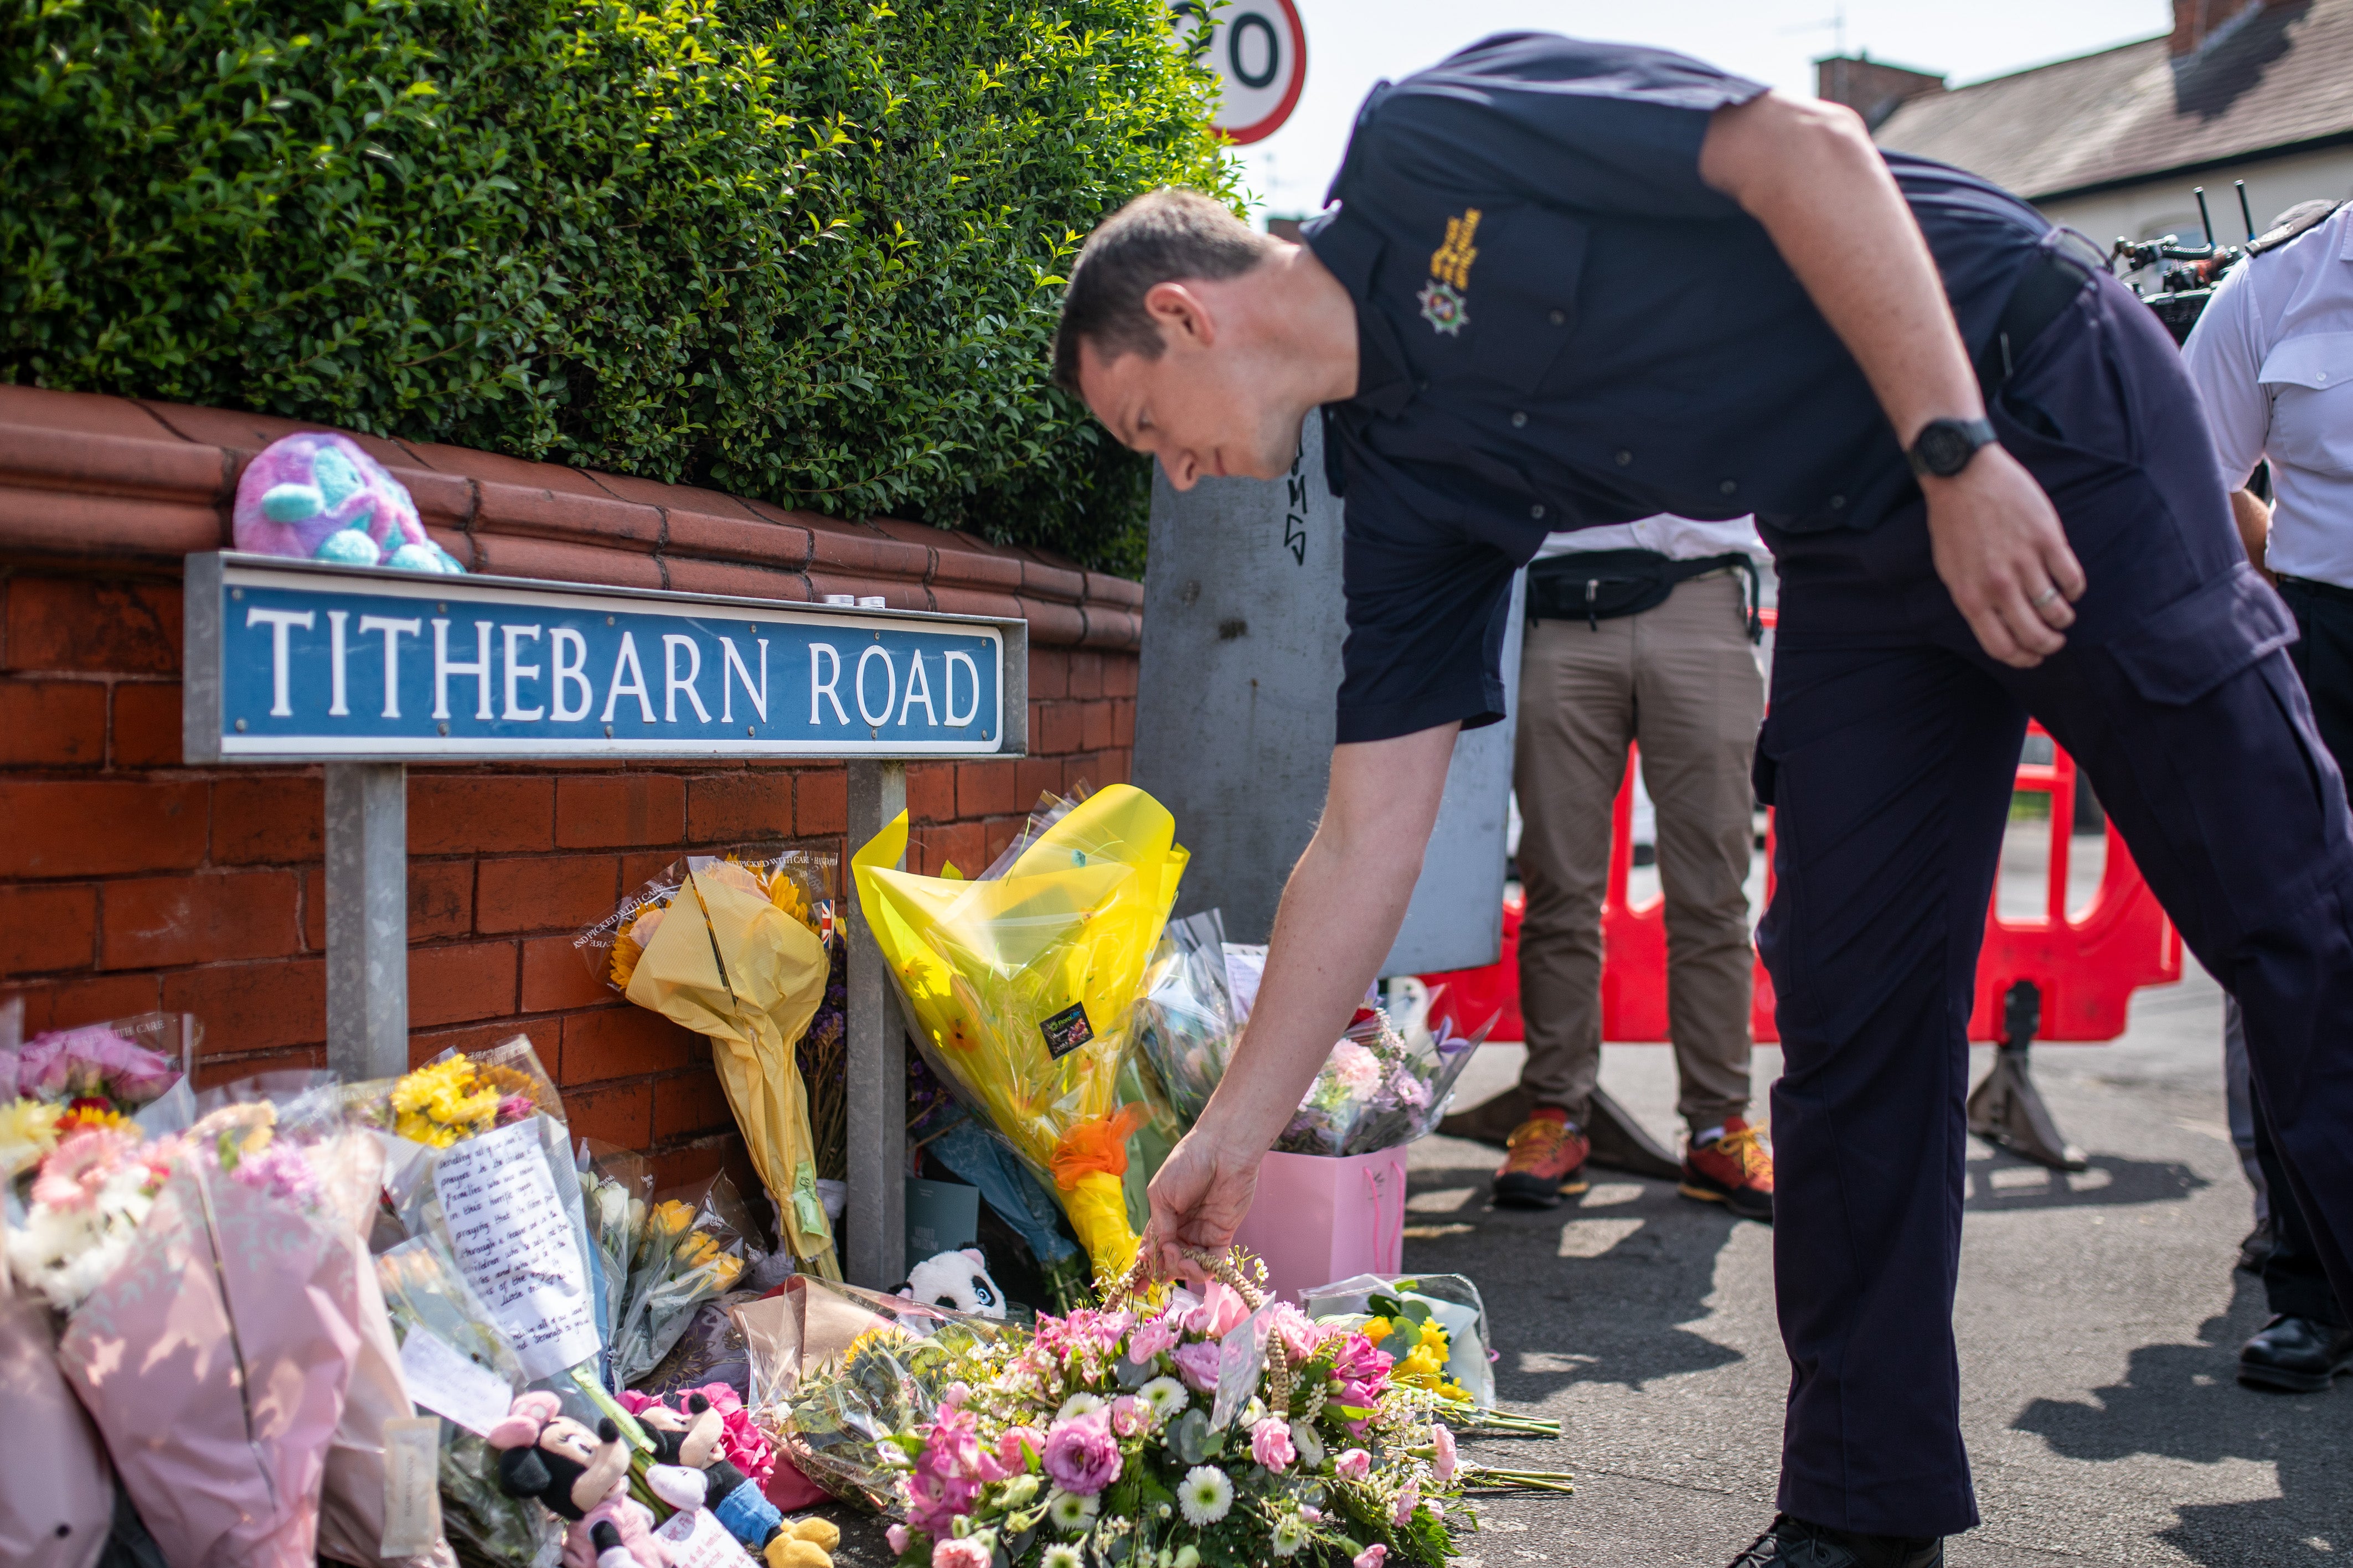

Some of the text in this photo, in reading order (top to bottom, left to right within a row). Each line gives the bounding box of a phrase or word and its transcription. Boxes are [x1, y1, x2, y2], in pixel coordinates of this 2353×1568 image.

[246, 607, 981, 728] TITHEBARN ROAD
[739, 859, 770, 868] PICKED
[769, 856, 793, 866] WITH
[586, 913, 620, 940] PICKED
[617, 898, 643, 918] WITH
[641, 882, 666, 902] CARE
[136, 1020, 165, 1034] CARE
